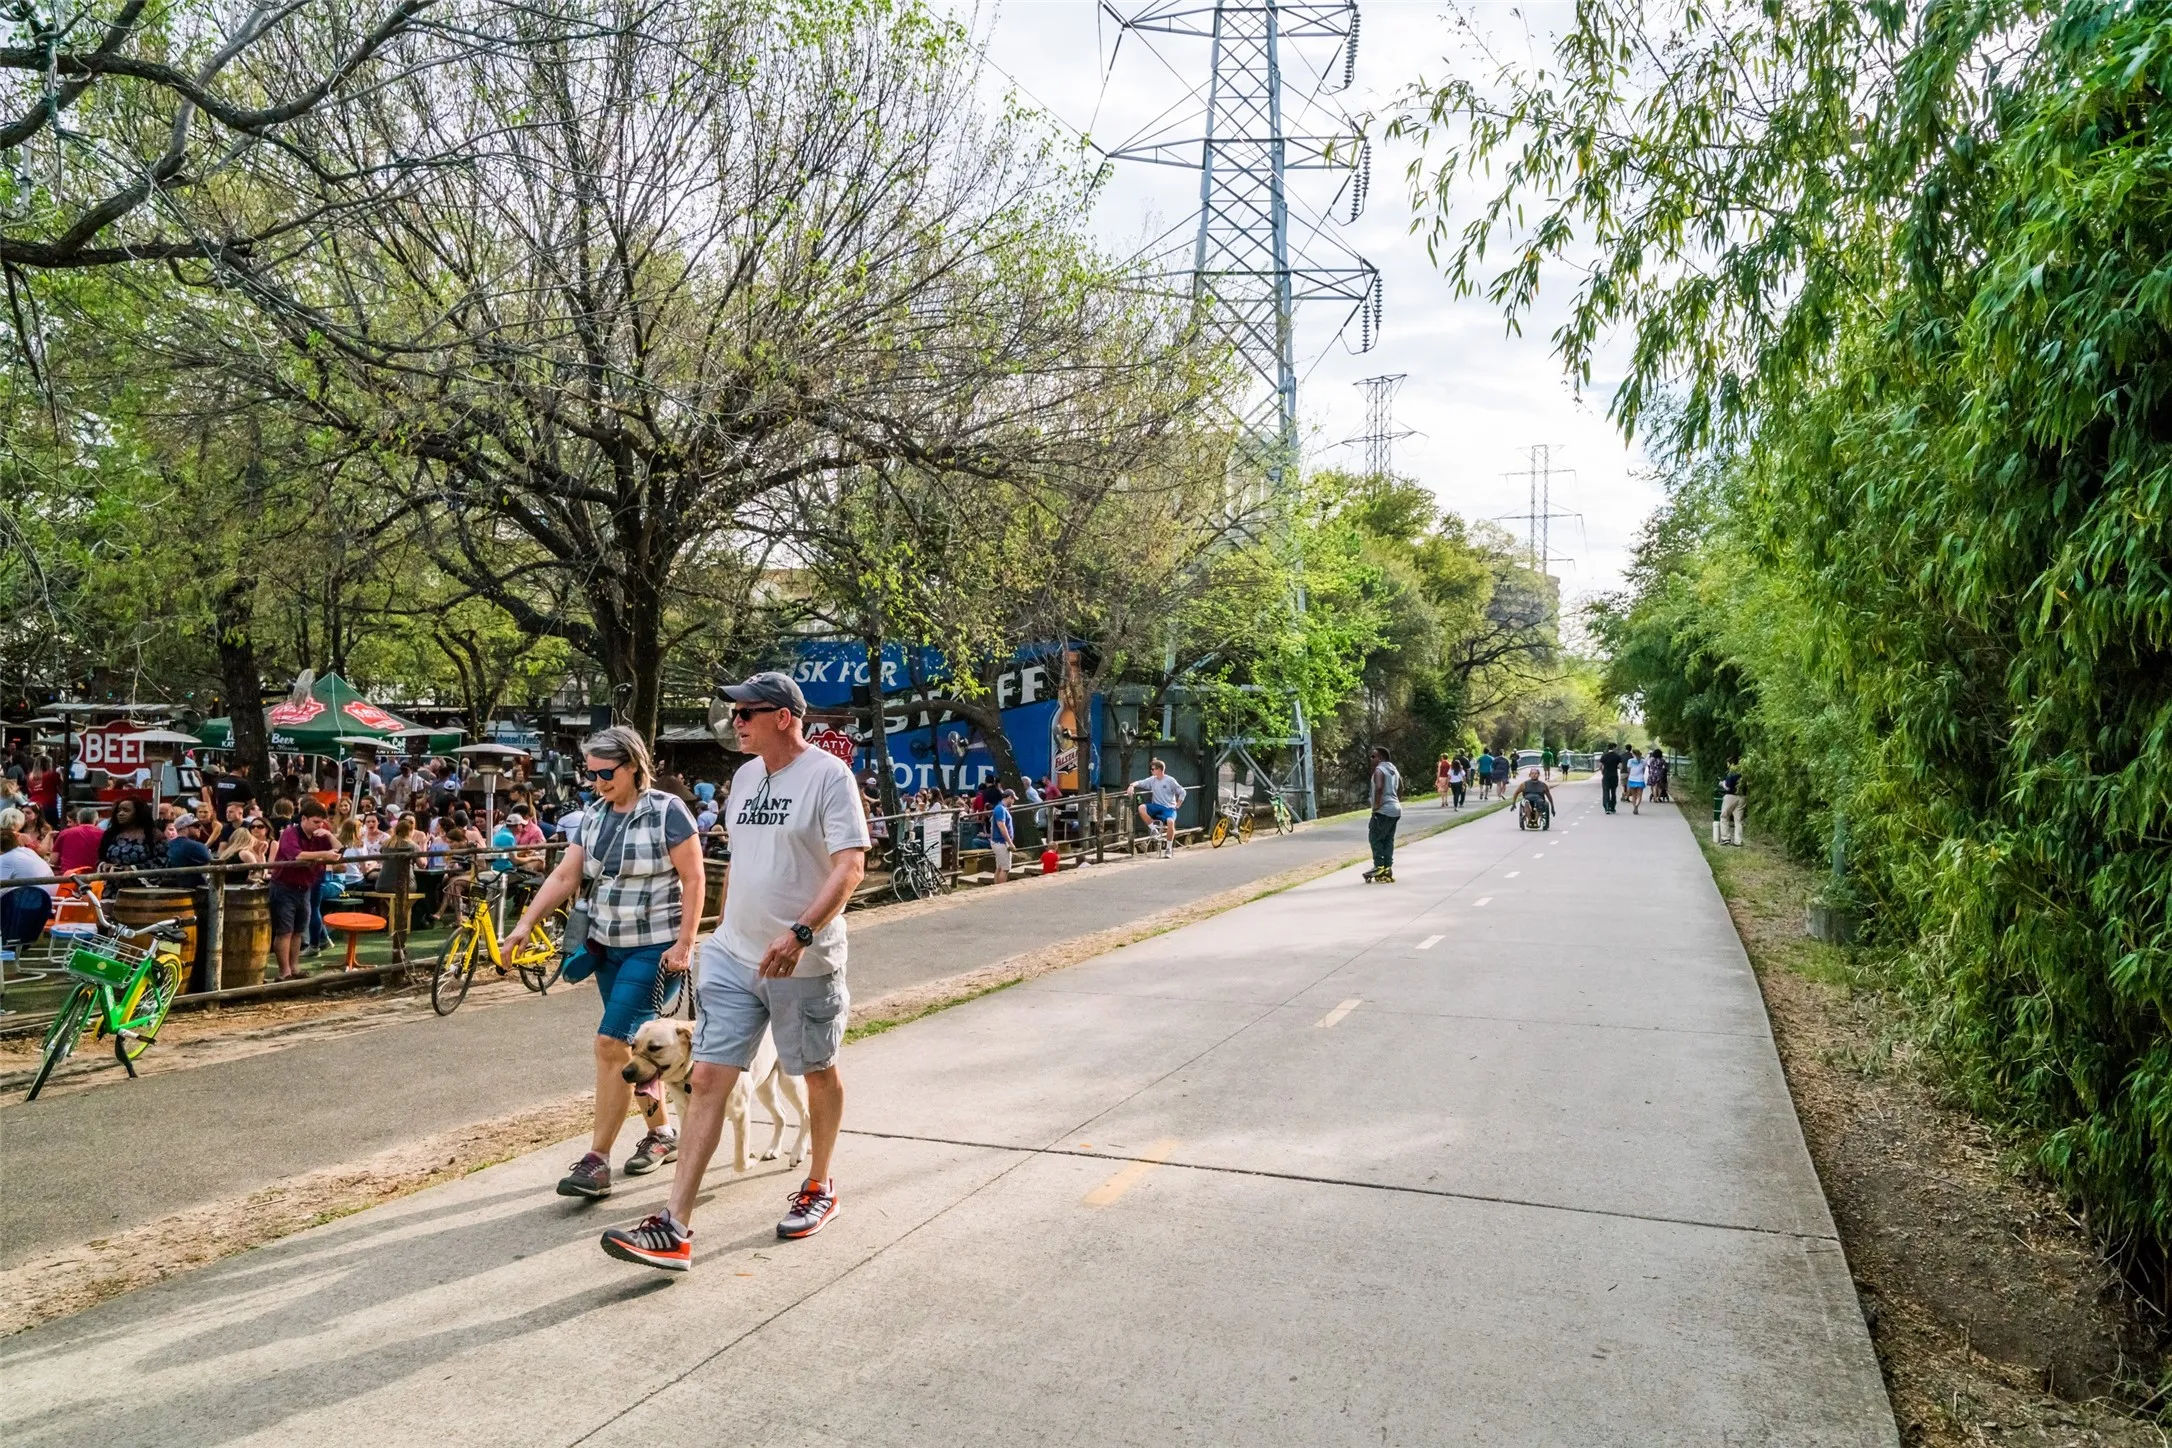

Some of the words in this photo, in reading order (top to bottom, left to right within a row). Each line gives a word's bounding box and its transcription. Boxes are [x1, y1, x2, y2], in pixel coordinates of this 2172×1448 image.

[837, 661, 898, 687] FOR
[813, 740, 846, 749] KATY
[736, 812, 790, 825] DADDY
